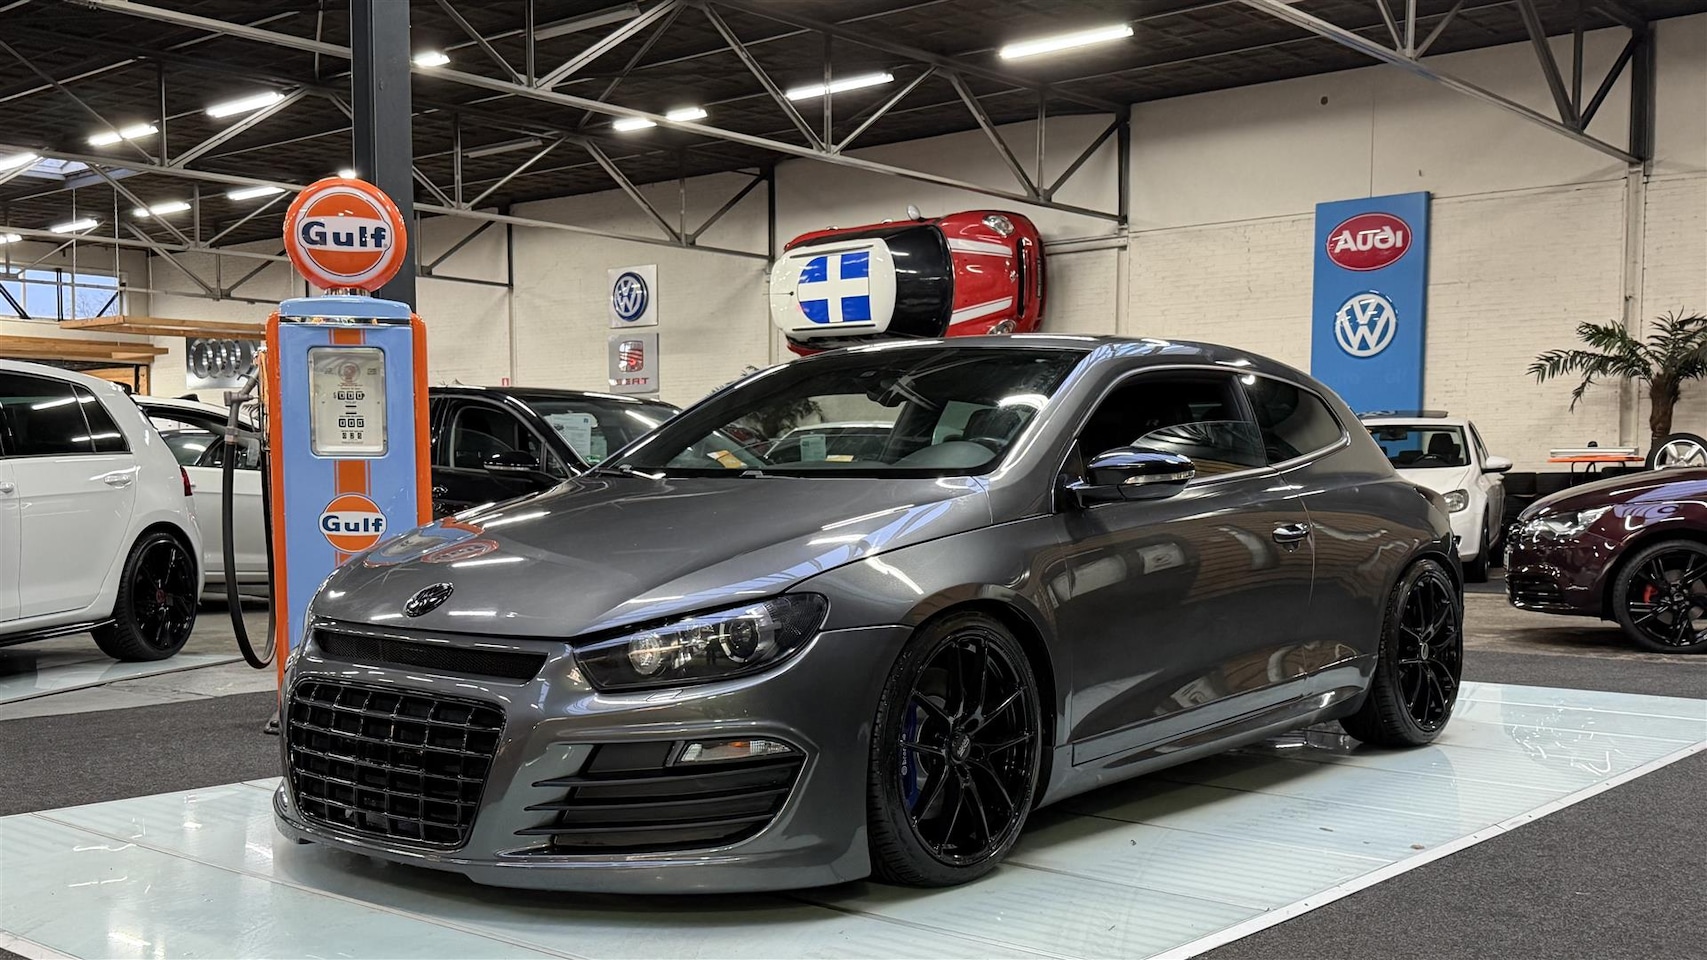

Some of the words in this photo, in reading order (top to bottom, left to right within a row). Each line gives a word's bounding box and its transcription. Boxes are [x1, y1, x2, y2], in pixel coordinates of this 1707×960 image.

[301, 221, 386, 248] Gulf
[1338, 297, 1393, 355] VW
[322, 515, 383, 533] Gulf
